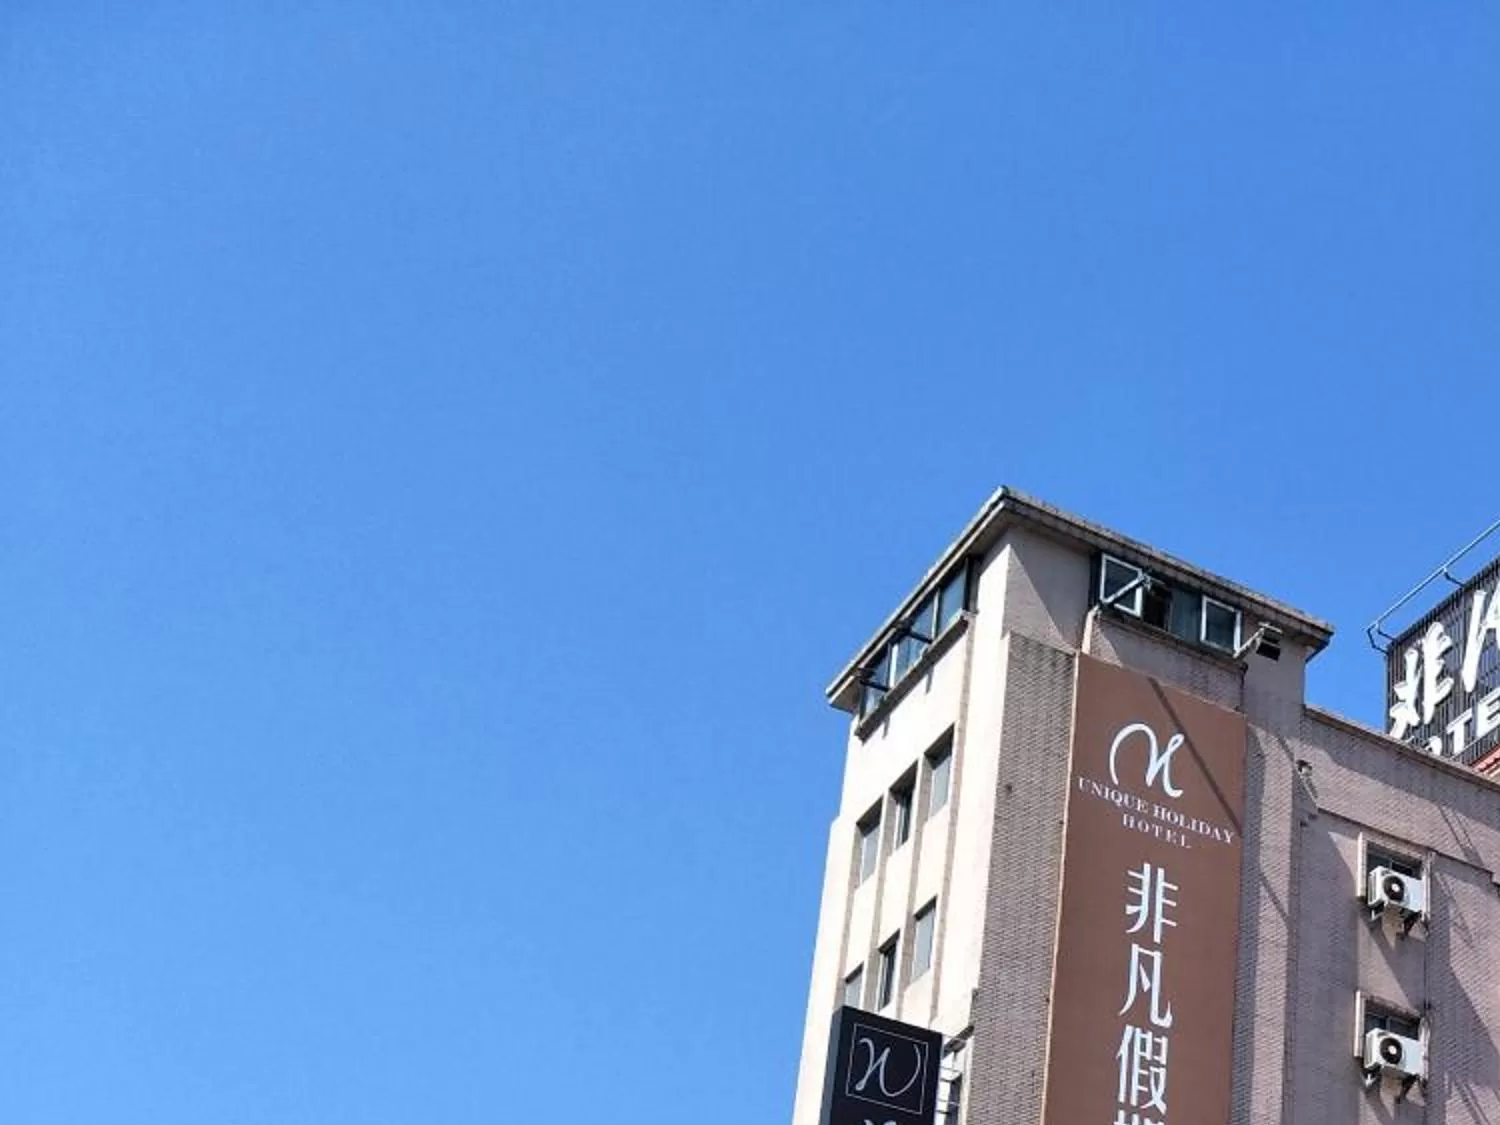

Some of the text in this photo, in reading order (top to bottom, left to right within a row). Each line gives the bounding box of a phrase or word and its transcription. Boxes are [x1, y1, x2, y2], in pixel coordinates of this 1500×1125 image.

[1078, 776, 1235, 846] UNIQUE HOLIDAY
[1122, 812, 1193, 850] HOTEL
